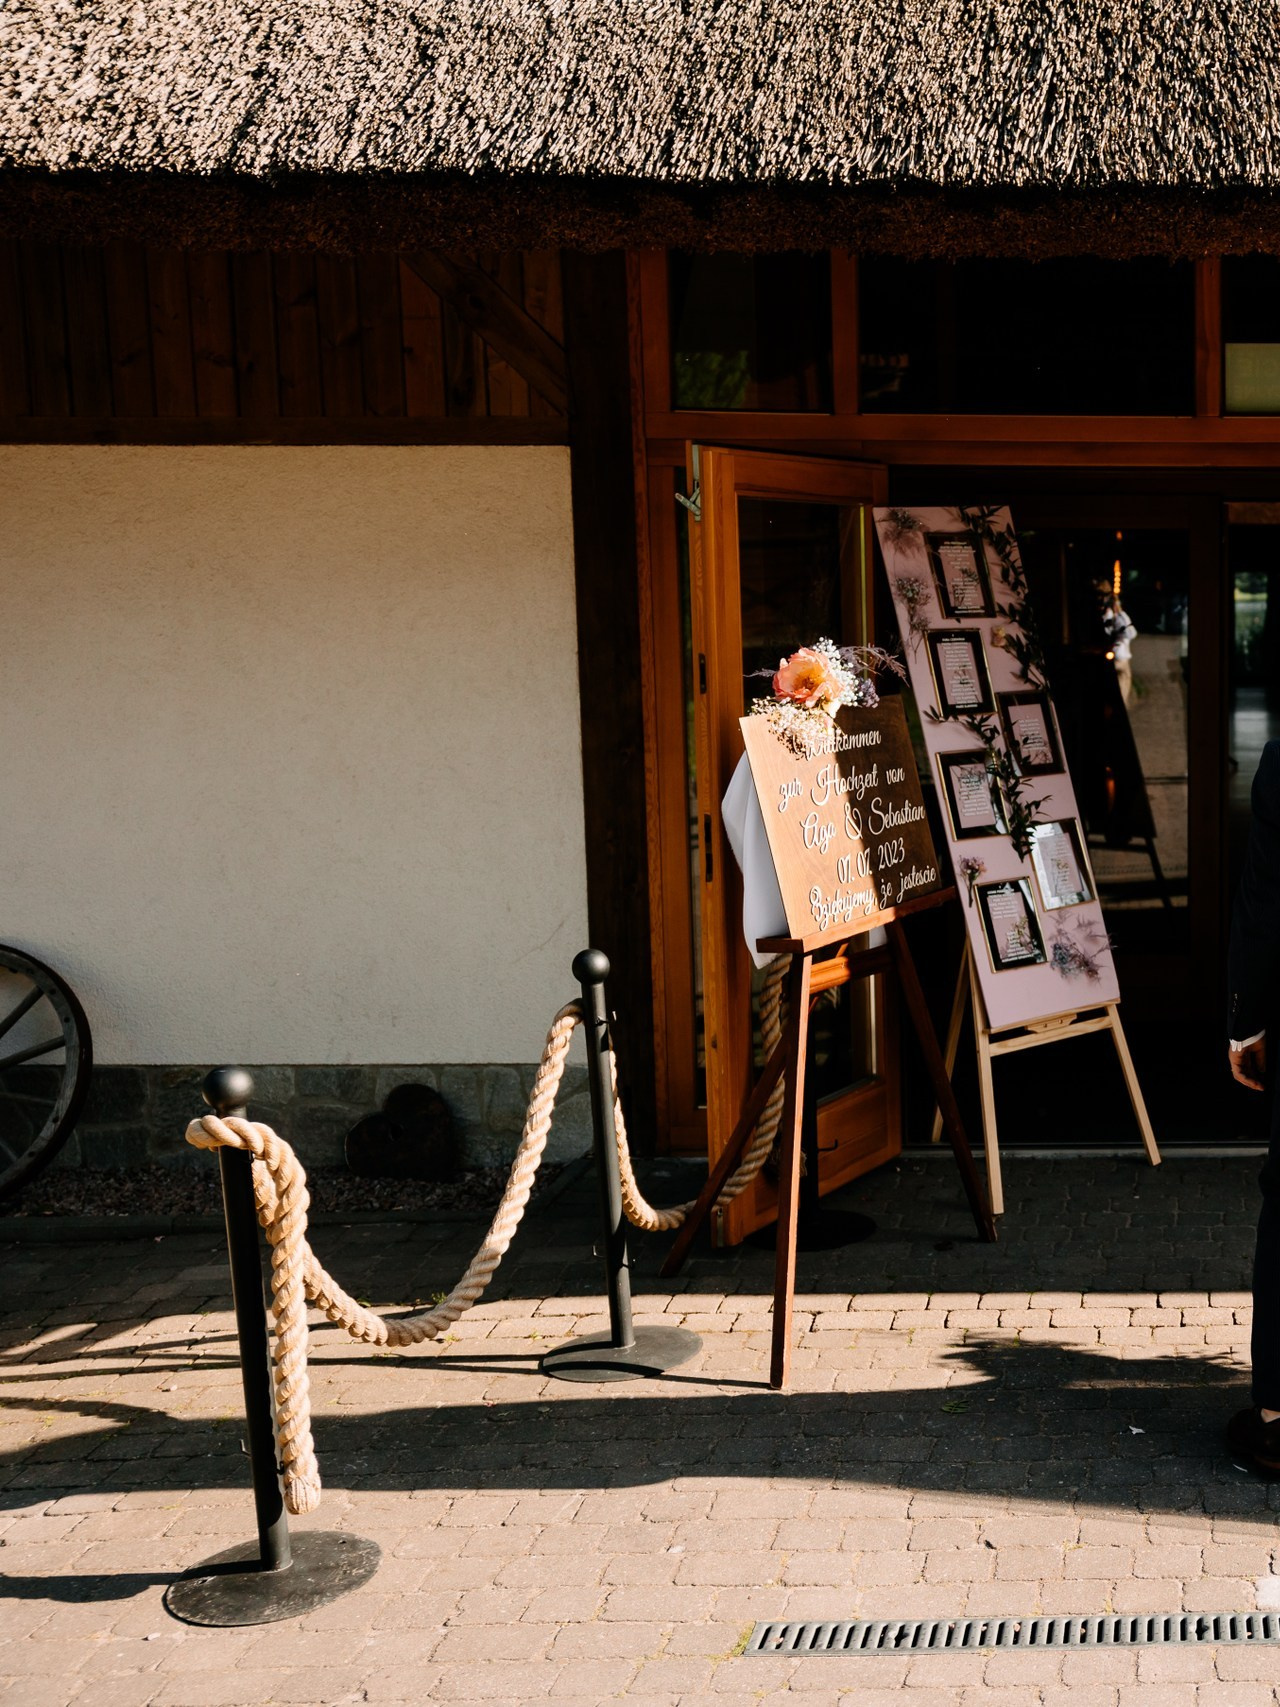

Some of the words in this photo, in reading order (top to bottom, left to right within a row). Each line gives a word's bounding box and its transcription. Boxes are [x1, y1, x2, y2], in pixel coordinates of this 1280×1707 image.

[778, 777, 804, 813] zur
[811, 763, 879, 806] Hochzeit
[886, 766, 906, 784] von
[800, 811, 837, 854] Aga
[844, 802, 864, 840] &
[868, 797, 926, 836] Sebastian
[877, 837, 906, 872] 2023
[879, 878, 894, 910] że
